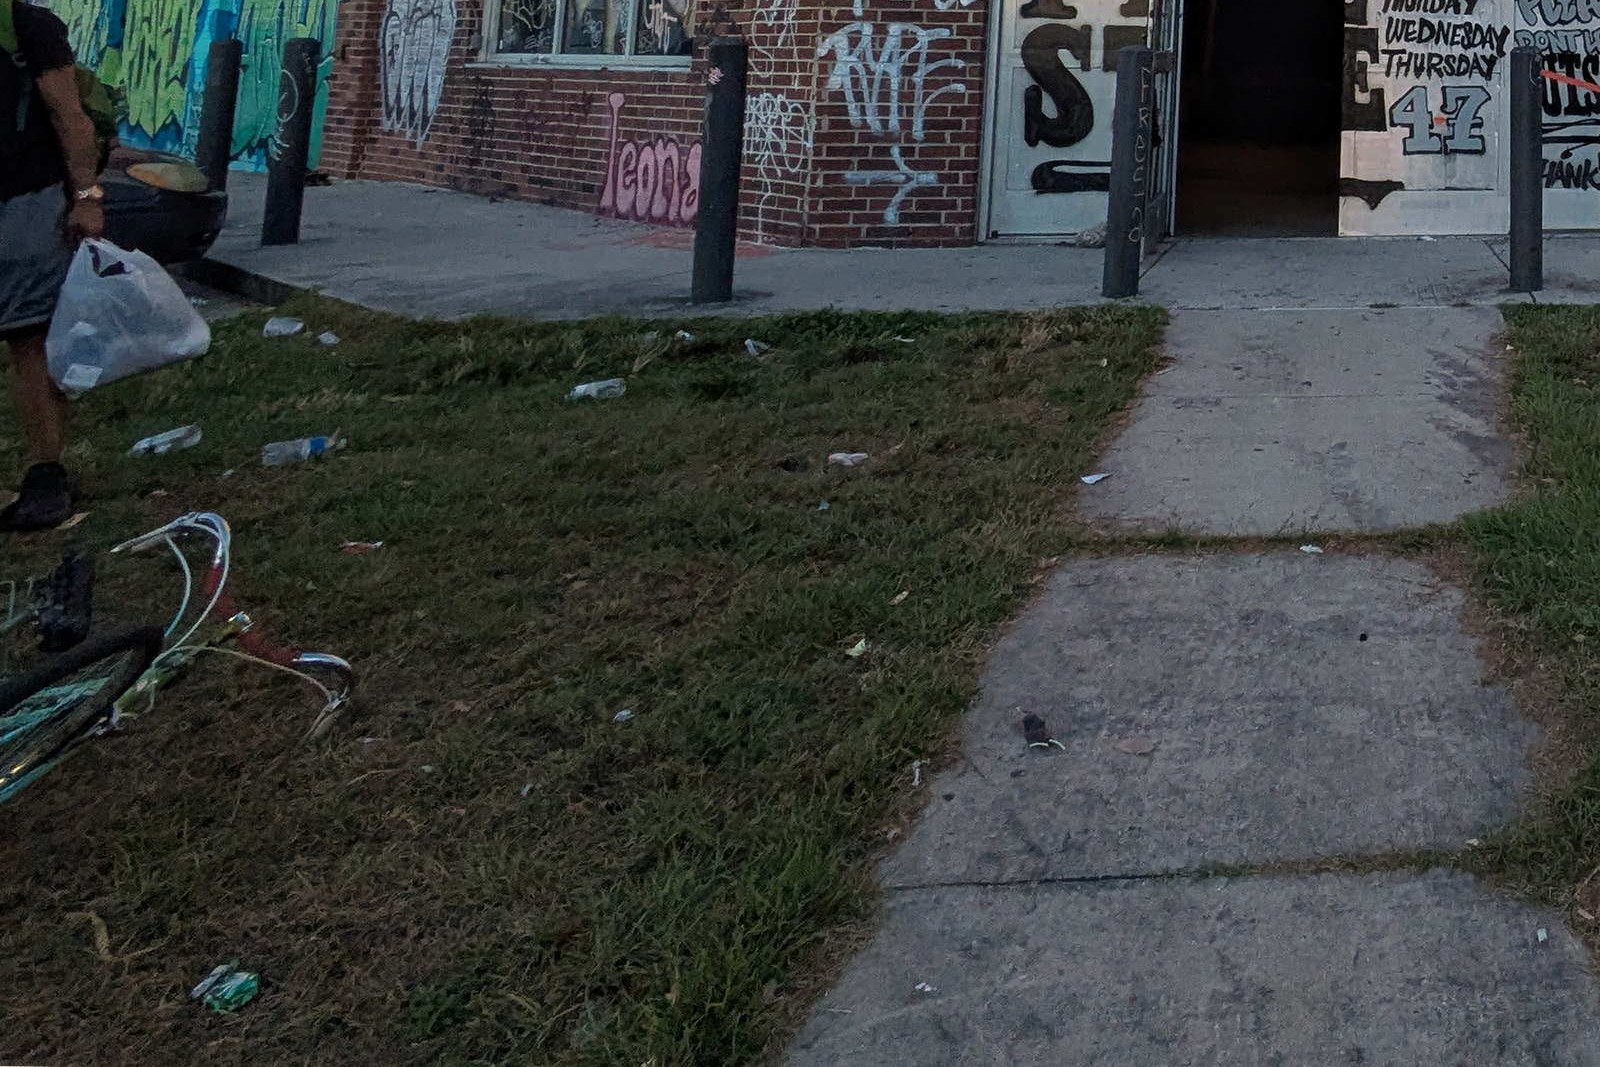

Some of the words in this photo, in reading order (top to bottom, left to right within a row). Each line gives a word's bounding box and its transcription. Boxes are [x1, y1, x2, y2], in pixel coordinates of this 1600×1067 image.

[1386, 16, 1511, 57] WEDNESDAY
[1513, 28, 1582, 55] DONT
[1381, 48, 1498, 81] THURSDAY
